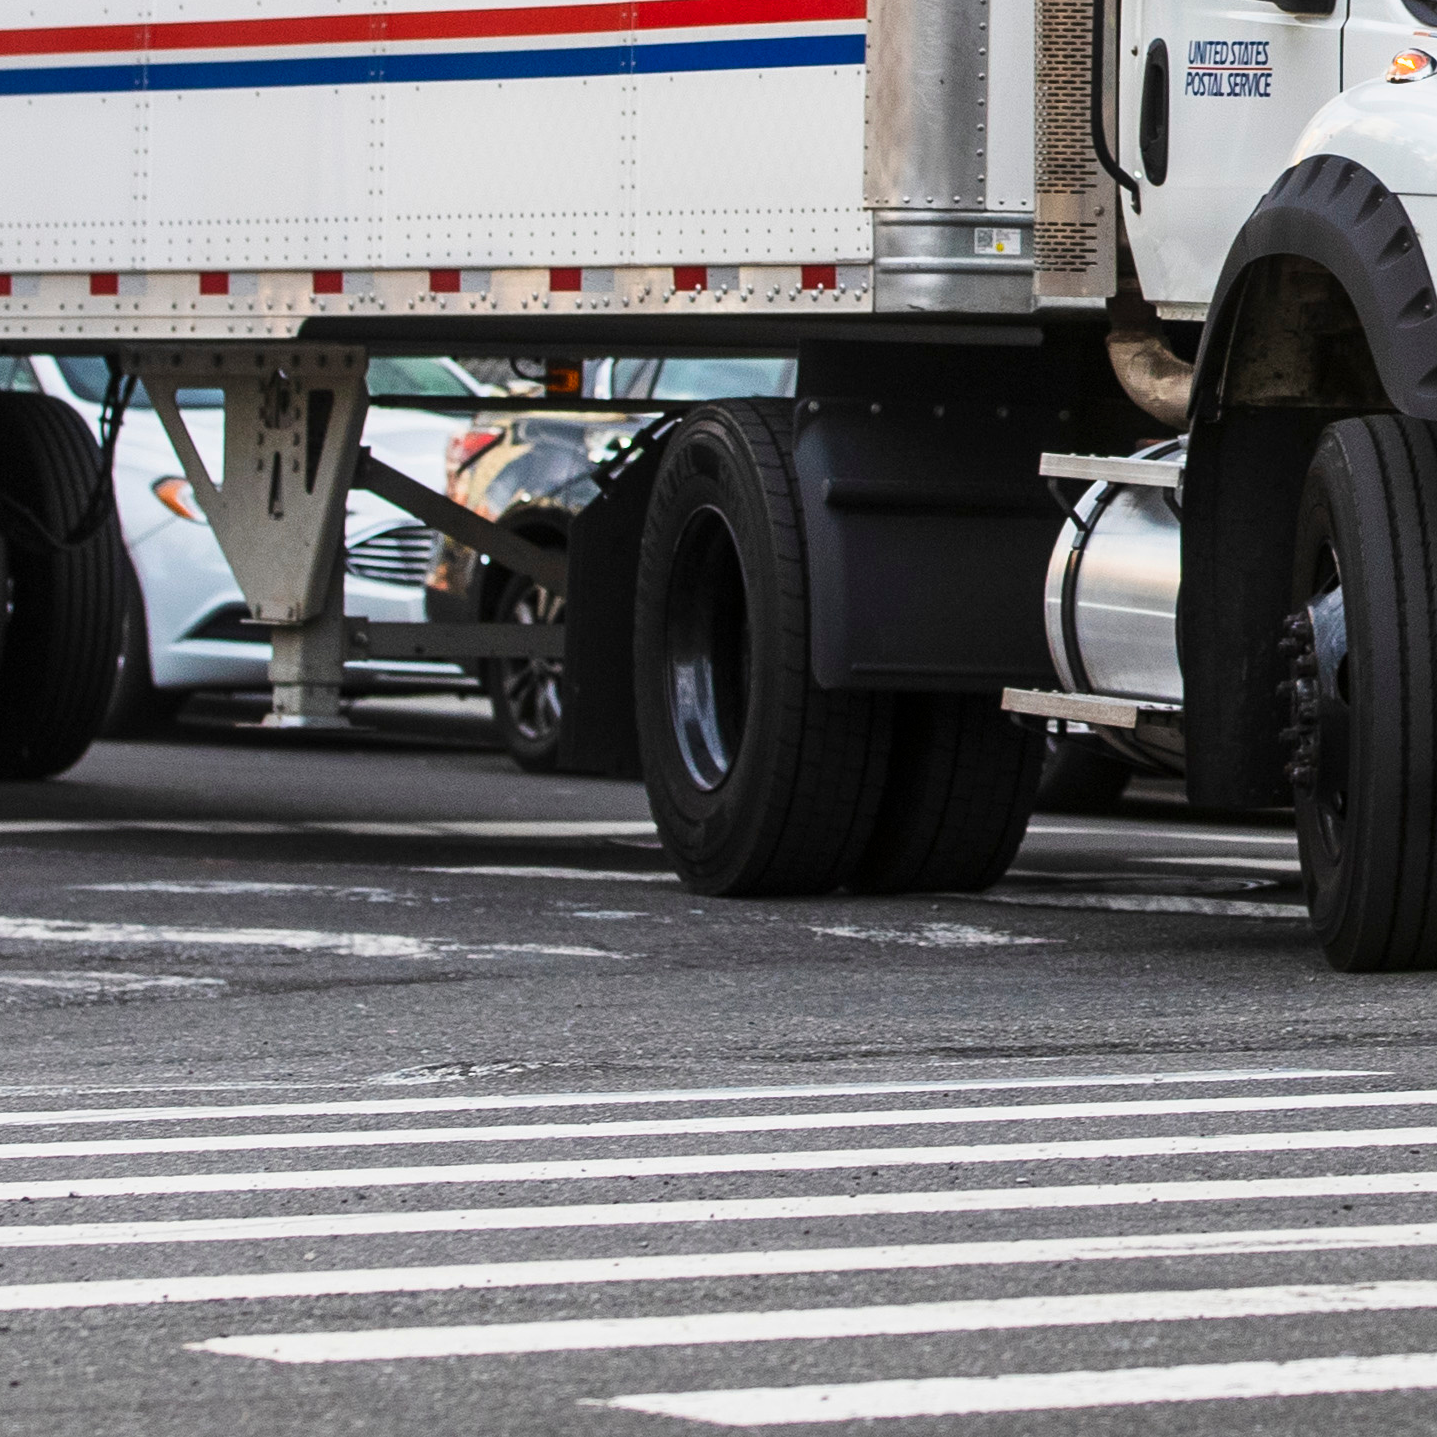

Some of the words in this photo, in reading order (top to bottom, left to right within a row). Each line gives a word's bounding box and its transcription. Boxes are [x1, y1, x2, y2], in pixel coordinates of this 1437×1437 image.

[1188, 41, 1229, 65] UNITED
[1229, 41, 1270, 66] STATES
[1185, 72, 1224, 97] POSTAL
[1226, 73, 1273, 98] SERVICE
